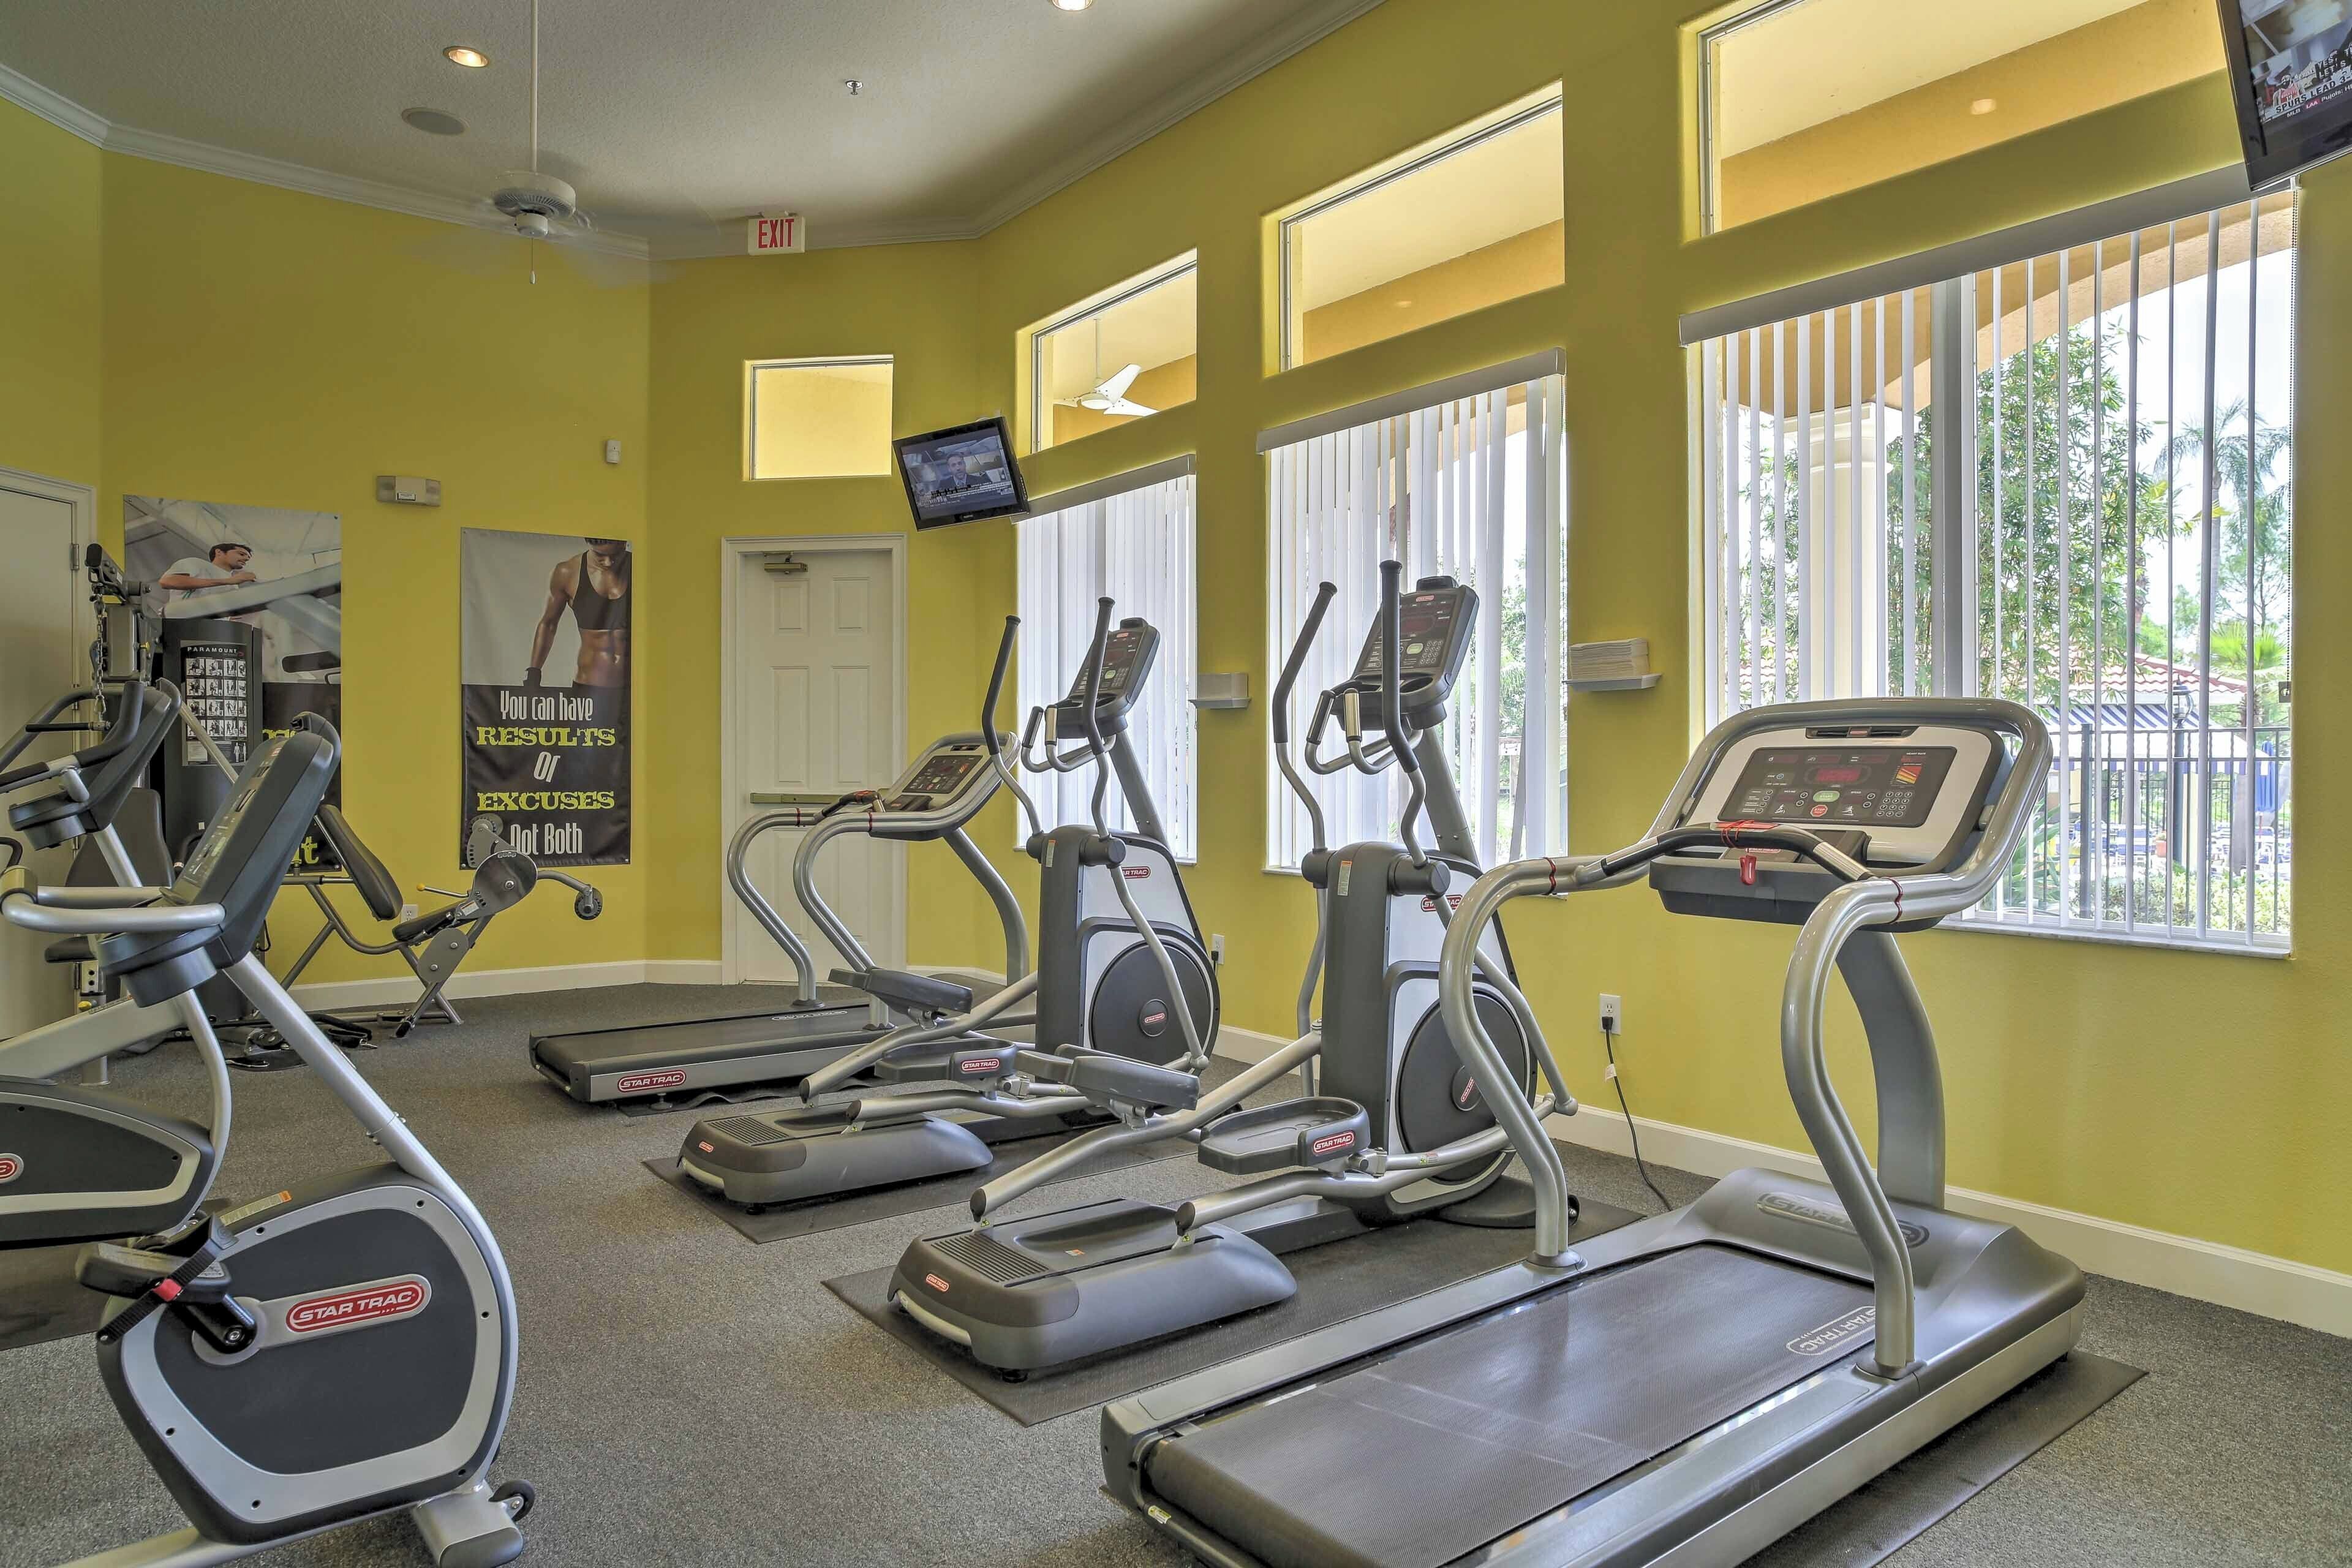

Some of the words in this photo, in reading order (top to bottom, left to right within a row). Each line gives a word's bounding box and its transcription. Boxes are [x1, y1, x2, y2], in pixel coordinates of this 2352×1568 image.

[2318, 60, 2346, 78] LET'S
[2276, 94, 2307, 113] SPURS
[2311, 80, 2335, 97] LEAD
[758, 218, 794, 248] EXIT
[500, 690, 527, 720] You
[532, 696, 555, 721] can
[559, 692, 594, 721] have
[477, 726, 616, 746] RESULTS
[533, 751, 560, 783] Or
[477, 791, 615, 811] EXCUSES
[544, 823, 582, 854] Both
[621, 1078, 650, 1088] STAR
[651, 1075, 680, 1084] TRAC
[1316, 1140, 1333, 1150] STAR
[1333, 1136, 1351, 1145] TRAC
[296, 1302, 353, 1323] STAR
[357, 1291, 413, 1311] TRAC
[1800, 1328, 1849, 1351] TRAC
